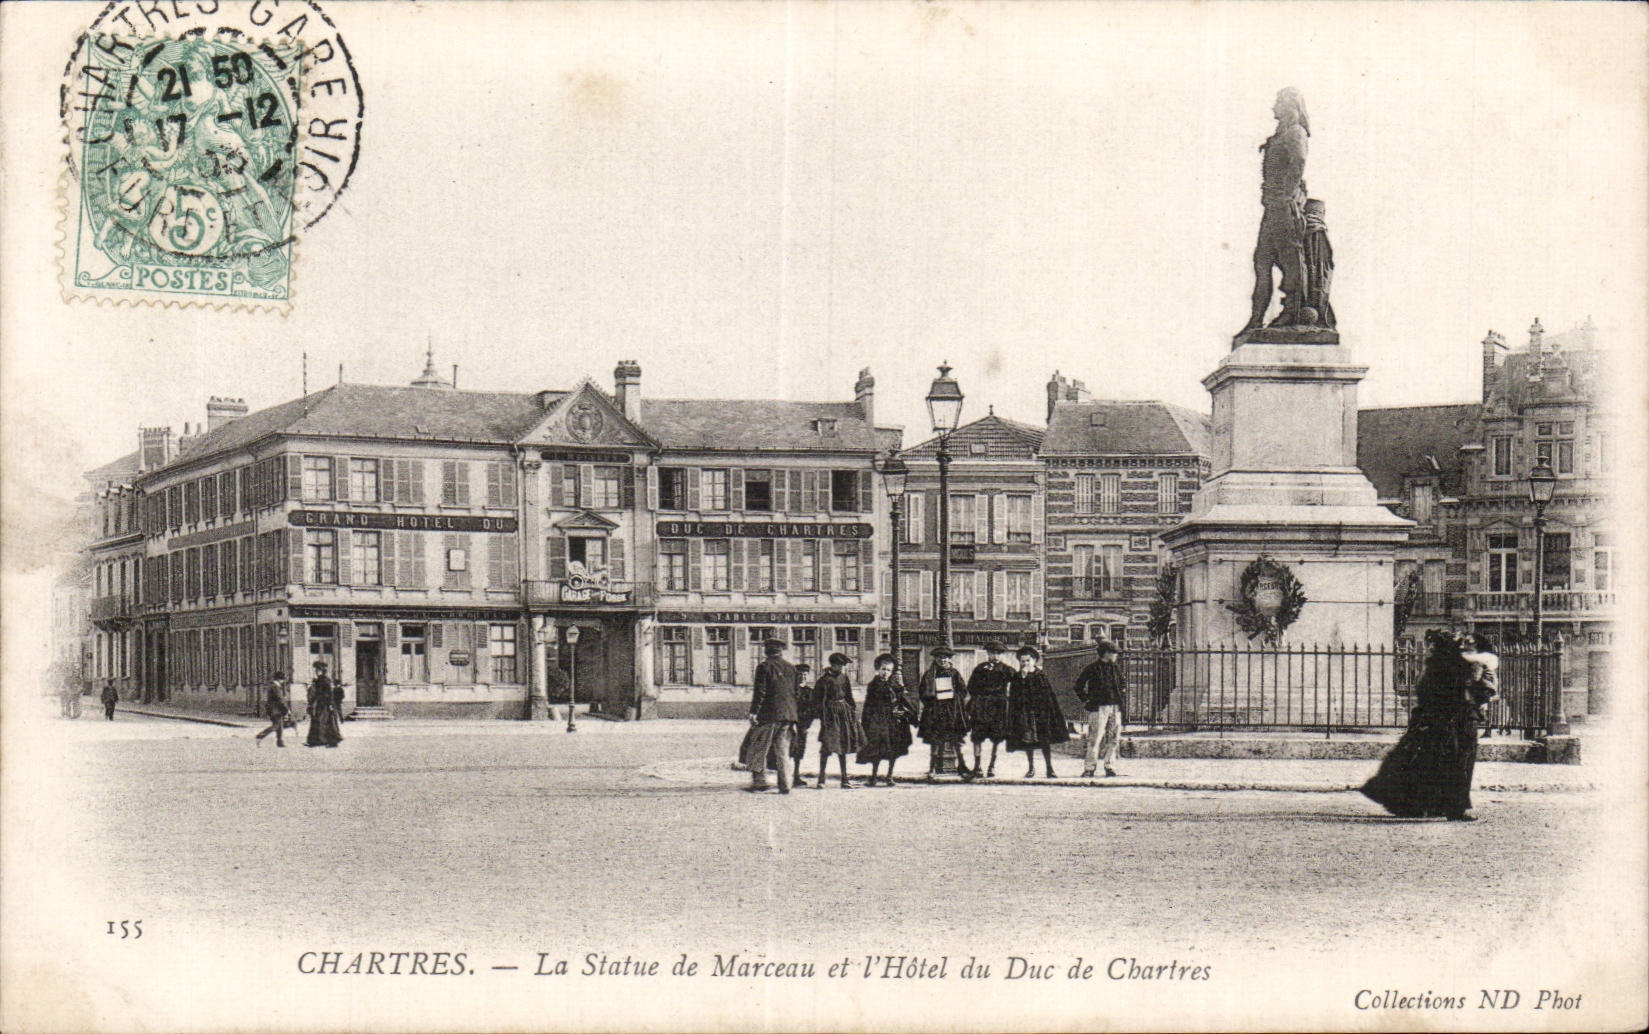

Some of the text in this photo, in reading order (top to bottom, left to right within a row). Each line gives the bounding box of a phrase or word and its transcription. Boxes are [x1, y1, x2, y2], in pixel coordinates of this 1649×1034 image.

[250, 0, 347, 98] GARE
[157, 51, 254, 102] 21 50
[155, 113, 188, 153] 17
[135, 266, 229, 292] POSTES
[305, 513, 505, 530] GRAND HOTEL DU
[670, 523, 860, 536] DUC DE CHARTRES
[714, 612, 761, 622] TABLE
